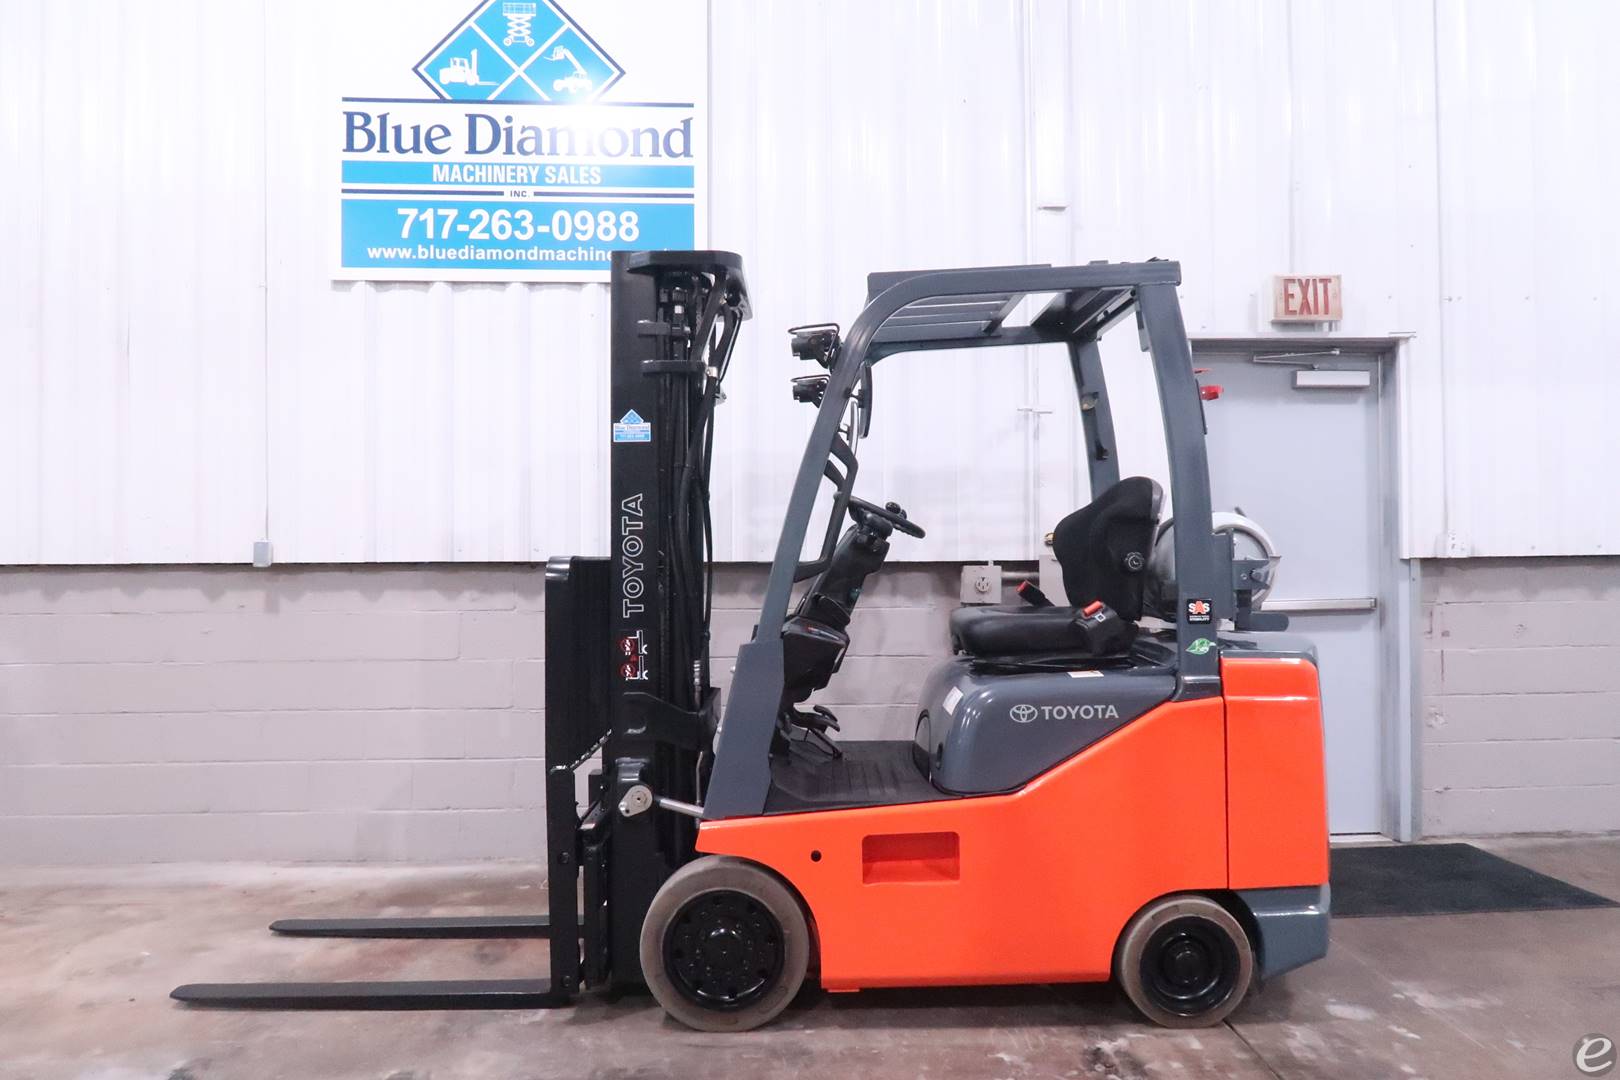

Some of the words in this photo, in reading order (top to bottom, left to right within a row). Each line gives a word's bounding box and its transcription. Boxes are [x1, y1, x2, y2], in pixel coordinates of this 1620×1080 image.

[342, 111, 452, 155] Blue
[464, 113, 694, 159] Diamond
[432, 163, 541, 184] MACHINERY
[545, 165, 602, 185] SALES
[509, 190, 530, 198] INC.
[397, 208, 640, 242] 717-263-0988
[1283, 278, 1332, 315] EXIT
[621, 493, 645, 618] TOYOTA
[1188, 600, 1210, 615] SAS
[1041, 705, 1119, 720] TOYOTA
